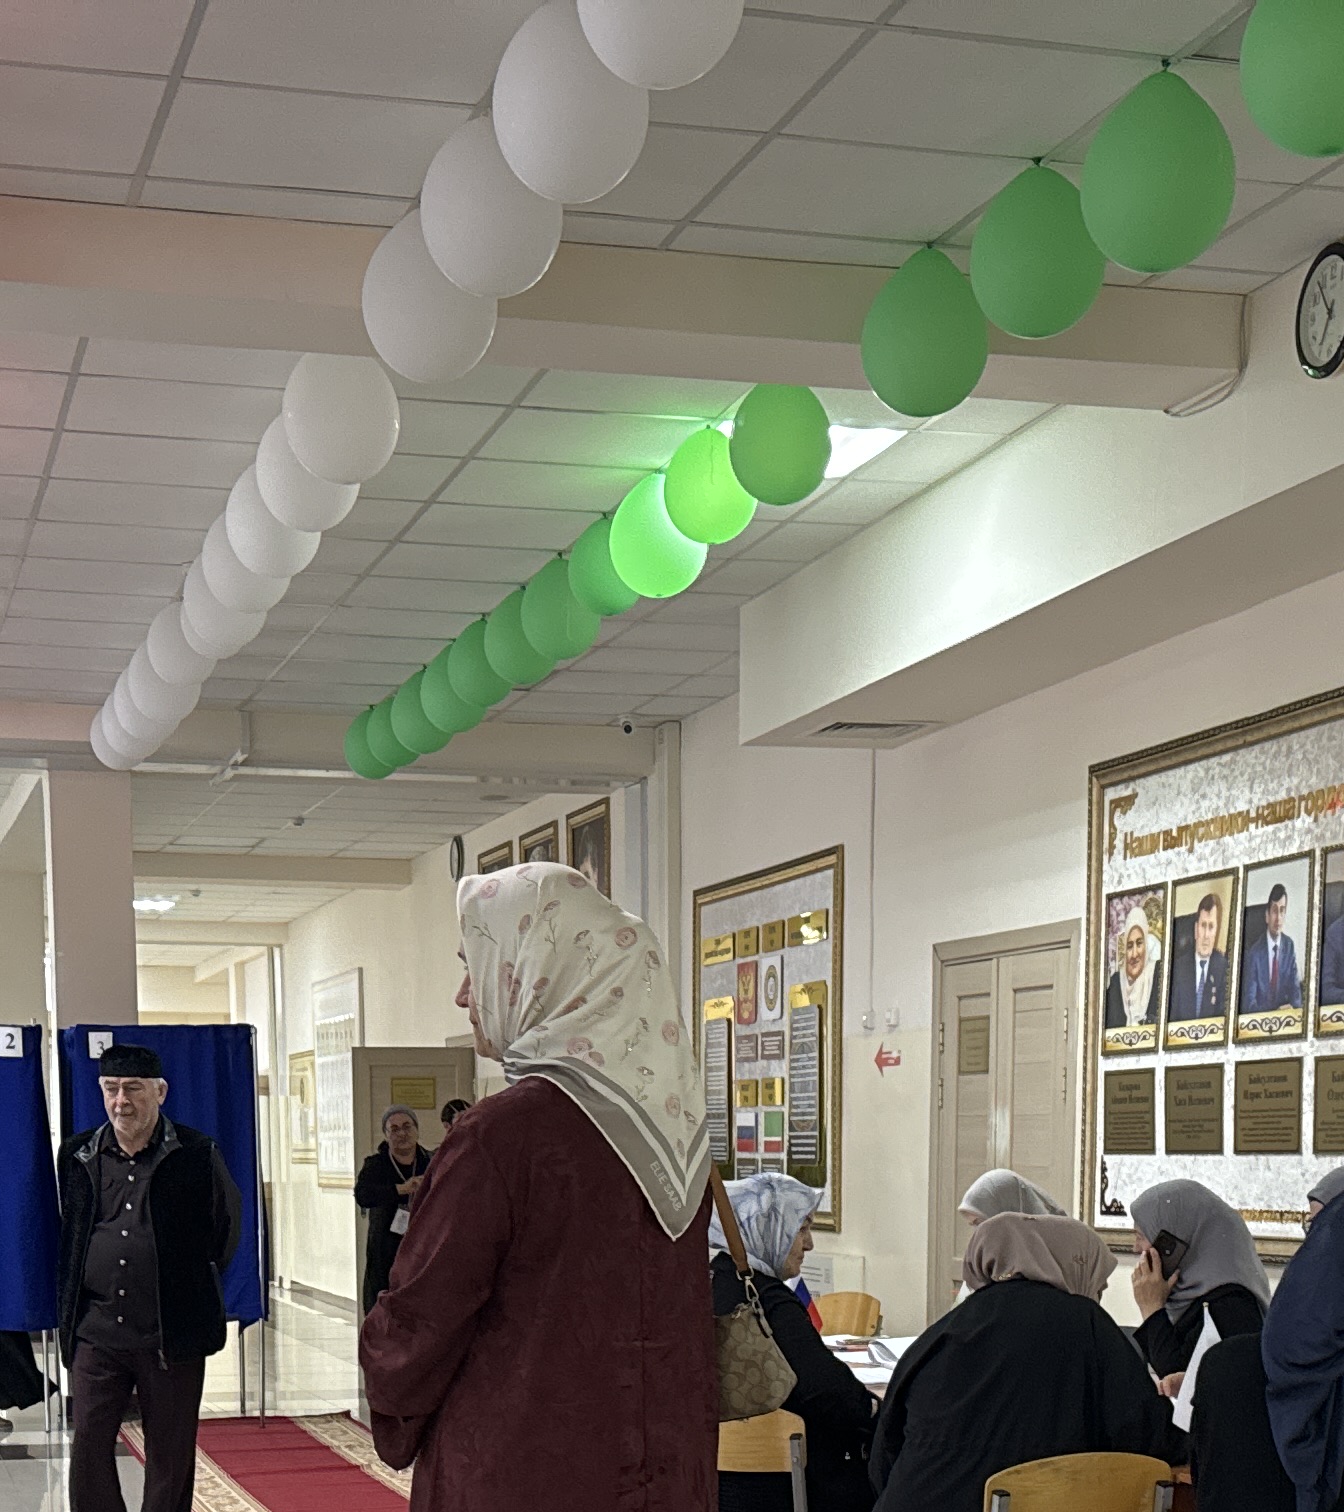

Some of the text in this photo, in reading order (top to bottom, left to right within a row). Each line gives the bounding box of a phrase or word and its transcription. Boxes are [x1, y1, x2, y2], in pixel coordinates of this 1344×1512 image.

[5, 1032, 16, 1050] 2
[96, 1040, 104, 1056] 3
[650, 1160, 682, 1212] ELIE SAAB
